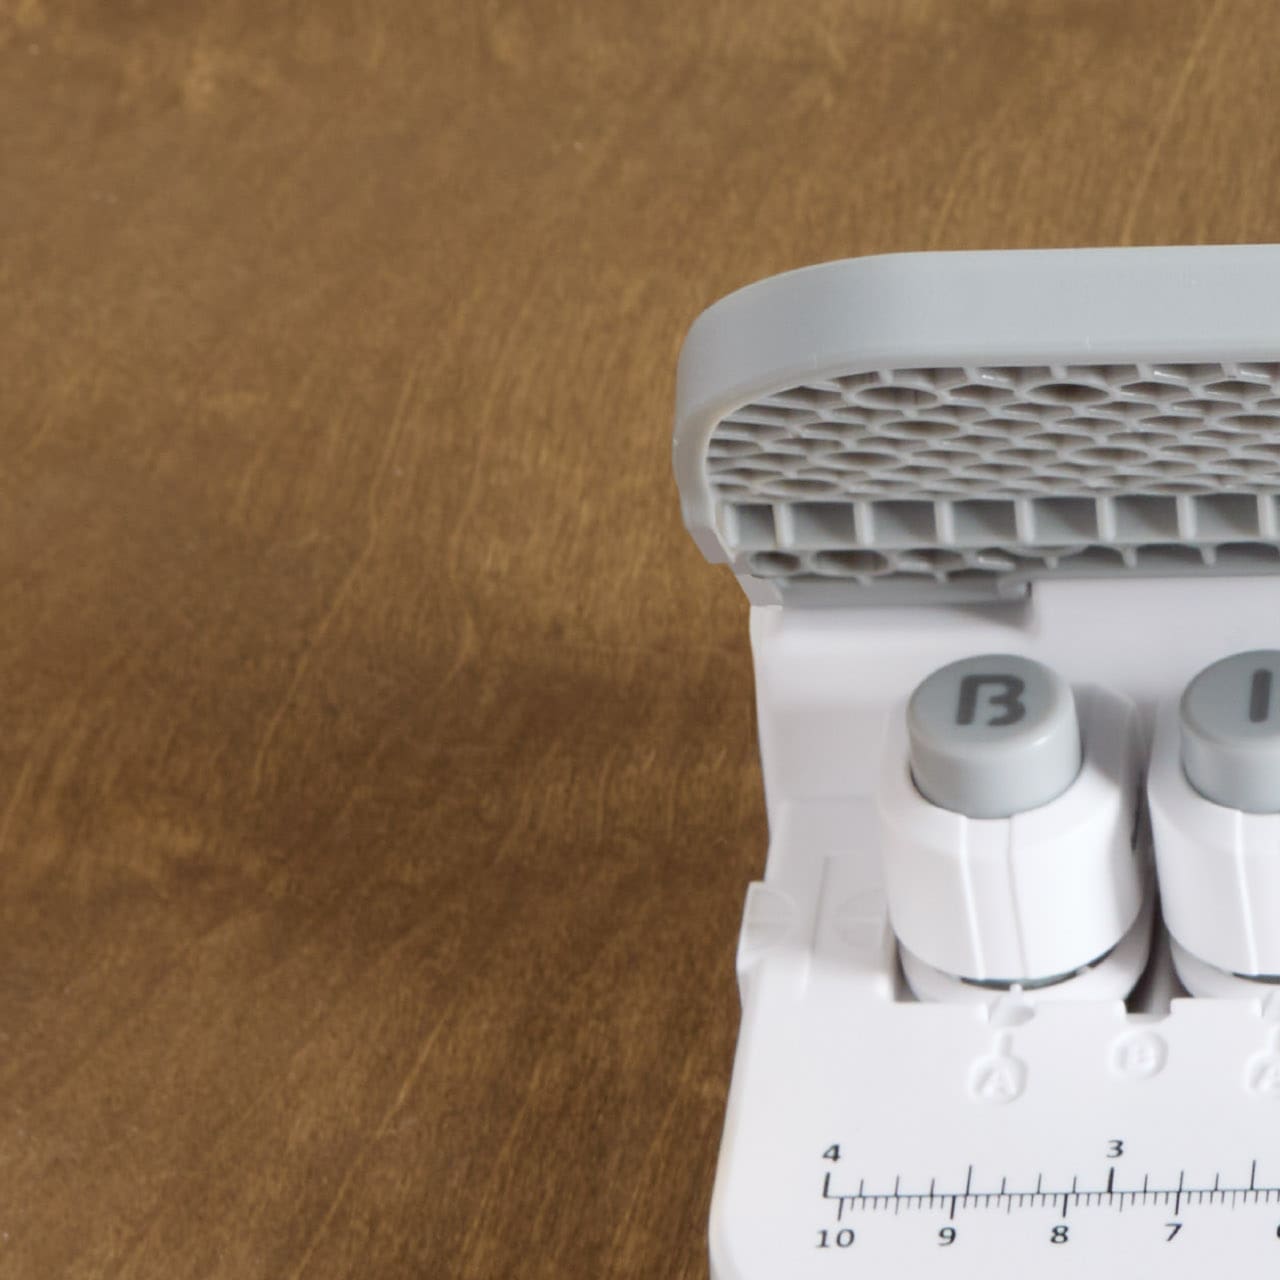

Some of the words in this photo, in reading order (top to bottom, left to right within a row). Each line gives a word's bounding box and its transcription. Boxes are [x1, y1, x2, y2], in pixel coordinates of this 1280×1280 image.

[953, 674, 1027, 726] B
[1248, 669, 1273, 723] I
[822, 1144, 841, 1162] 4
[1107, 1139, 1124, 1158] 3
[819, 1229, 855, 1249] 10
[938, 1226, 957, 1247] 9
[1050, 1225, 1069, 1245] 8
[1166, 1223, 1183, 1242] 7
